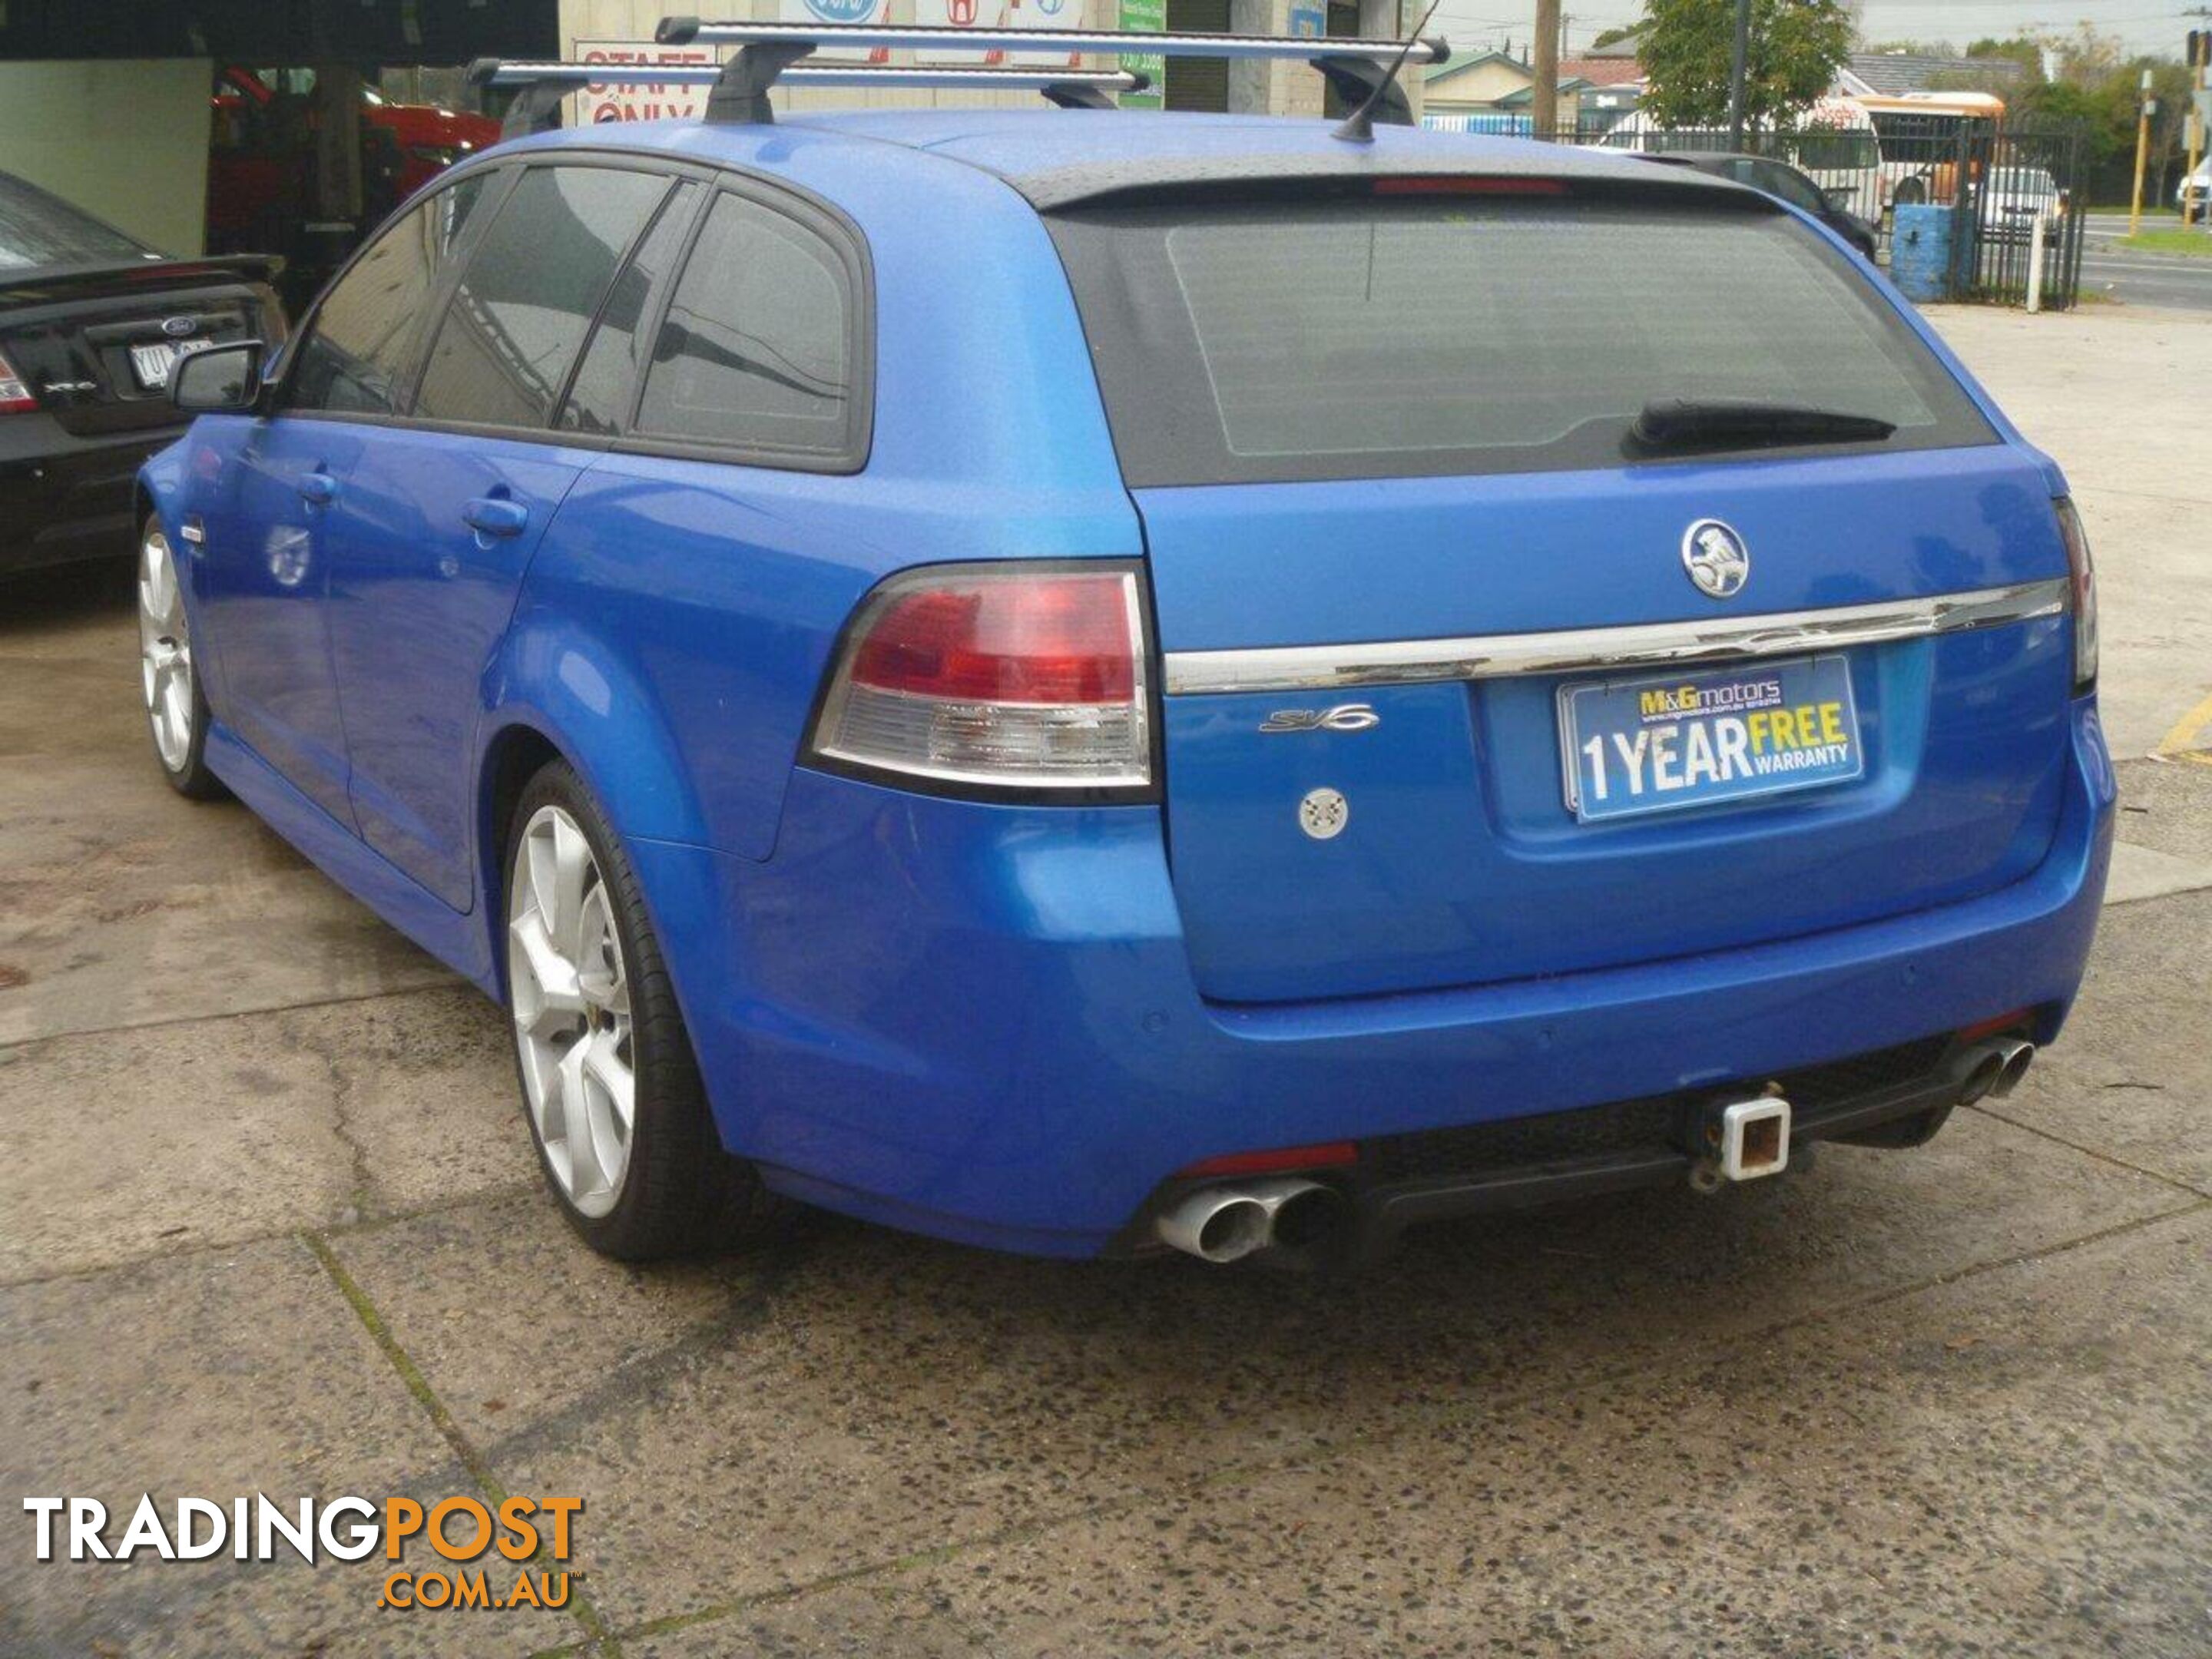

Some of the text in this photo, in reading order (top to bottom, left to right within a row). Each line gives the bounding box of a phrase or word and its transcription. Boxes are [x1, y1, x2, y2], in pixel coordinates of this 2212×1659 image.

[1258, 704, 1380, 732] SV6
[1613, 717, 1754, 794] YEAR
[1748, 702, 1847, 755] FREE
[1754, 743, 1848, 774] WARRANTY
